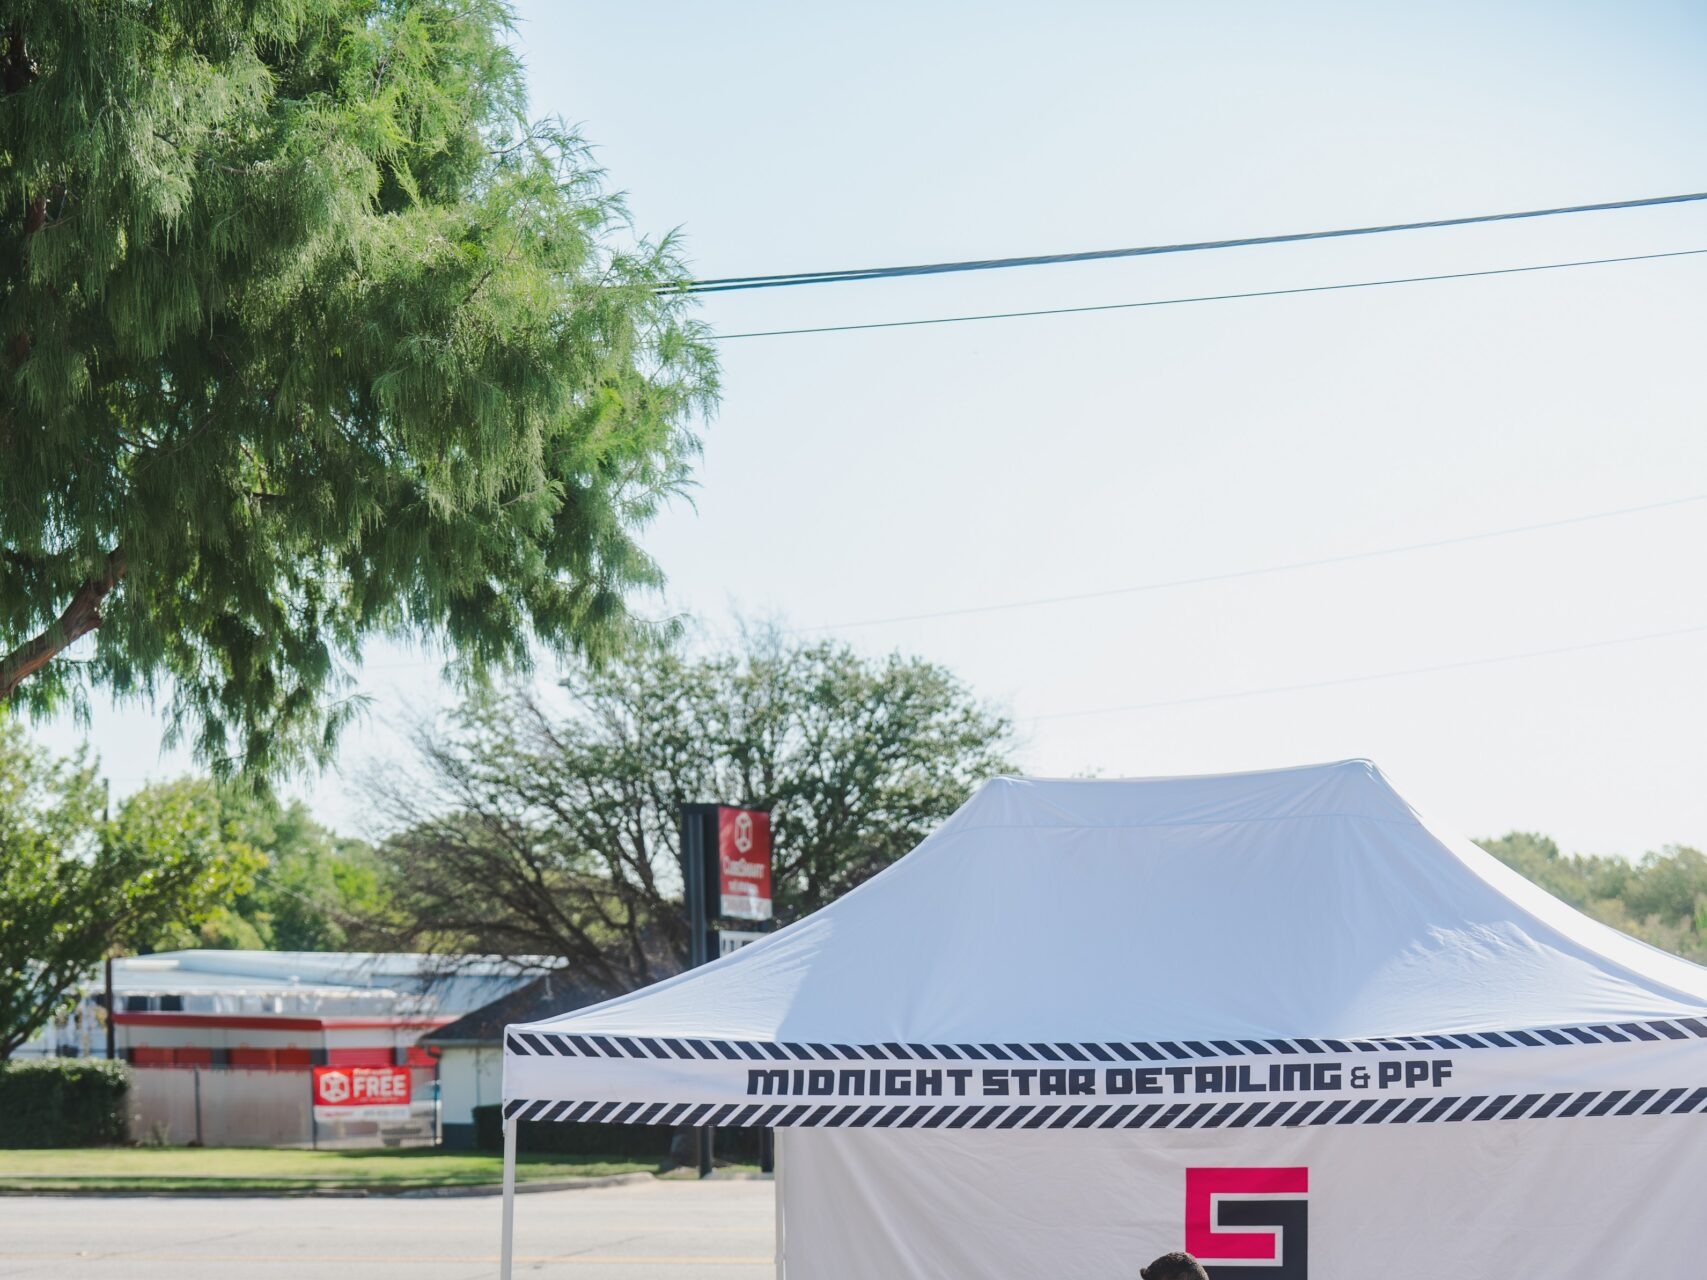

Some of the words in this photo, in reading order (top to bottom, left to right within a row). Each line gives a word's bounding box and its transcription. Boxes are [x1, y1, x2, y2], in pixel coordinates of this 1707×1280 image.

[353, 1074, 407, 1098] FREE
[747, 1068, 973, 1096] MIDNIGHT
[982, 1068, 1096, 1096] STAR
[1105, 1062, 1342, 1095] DETAILING
[1350, 1065, 1371, 1089] &
[1378, 1059, 1453, 1089] PPF
